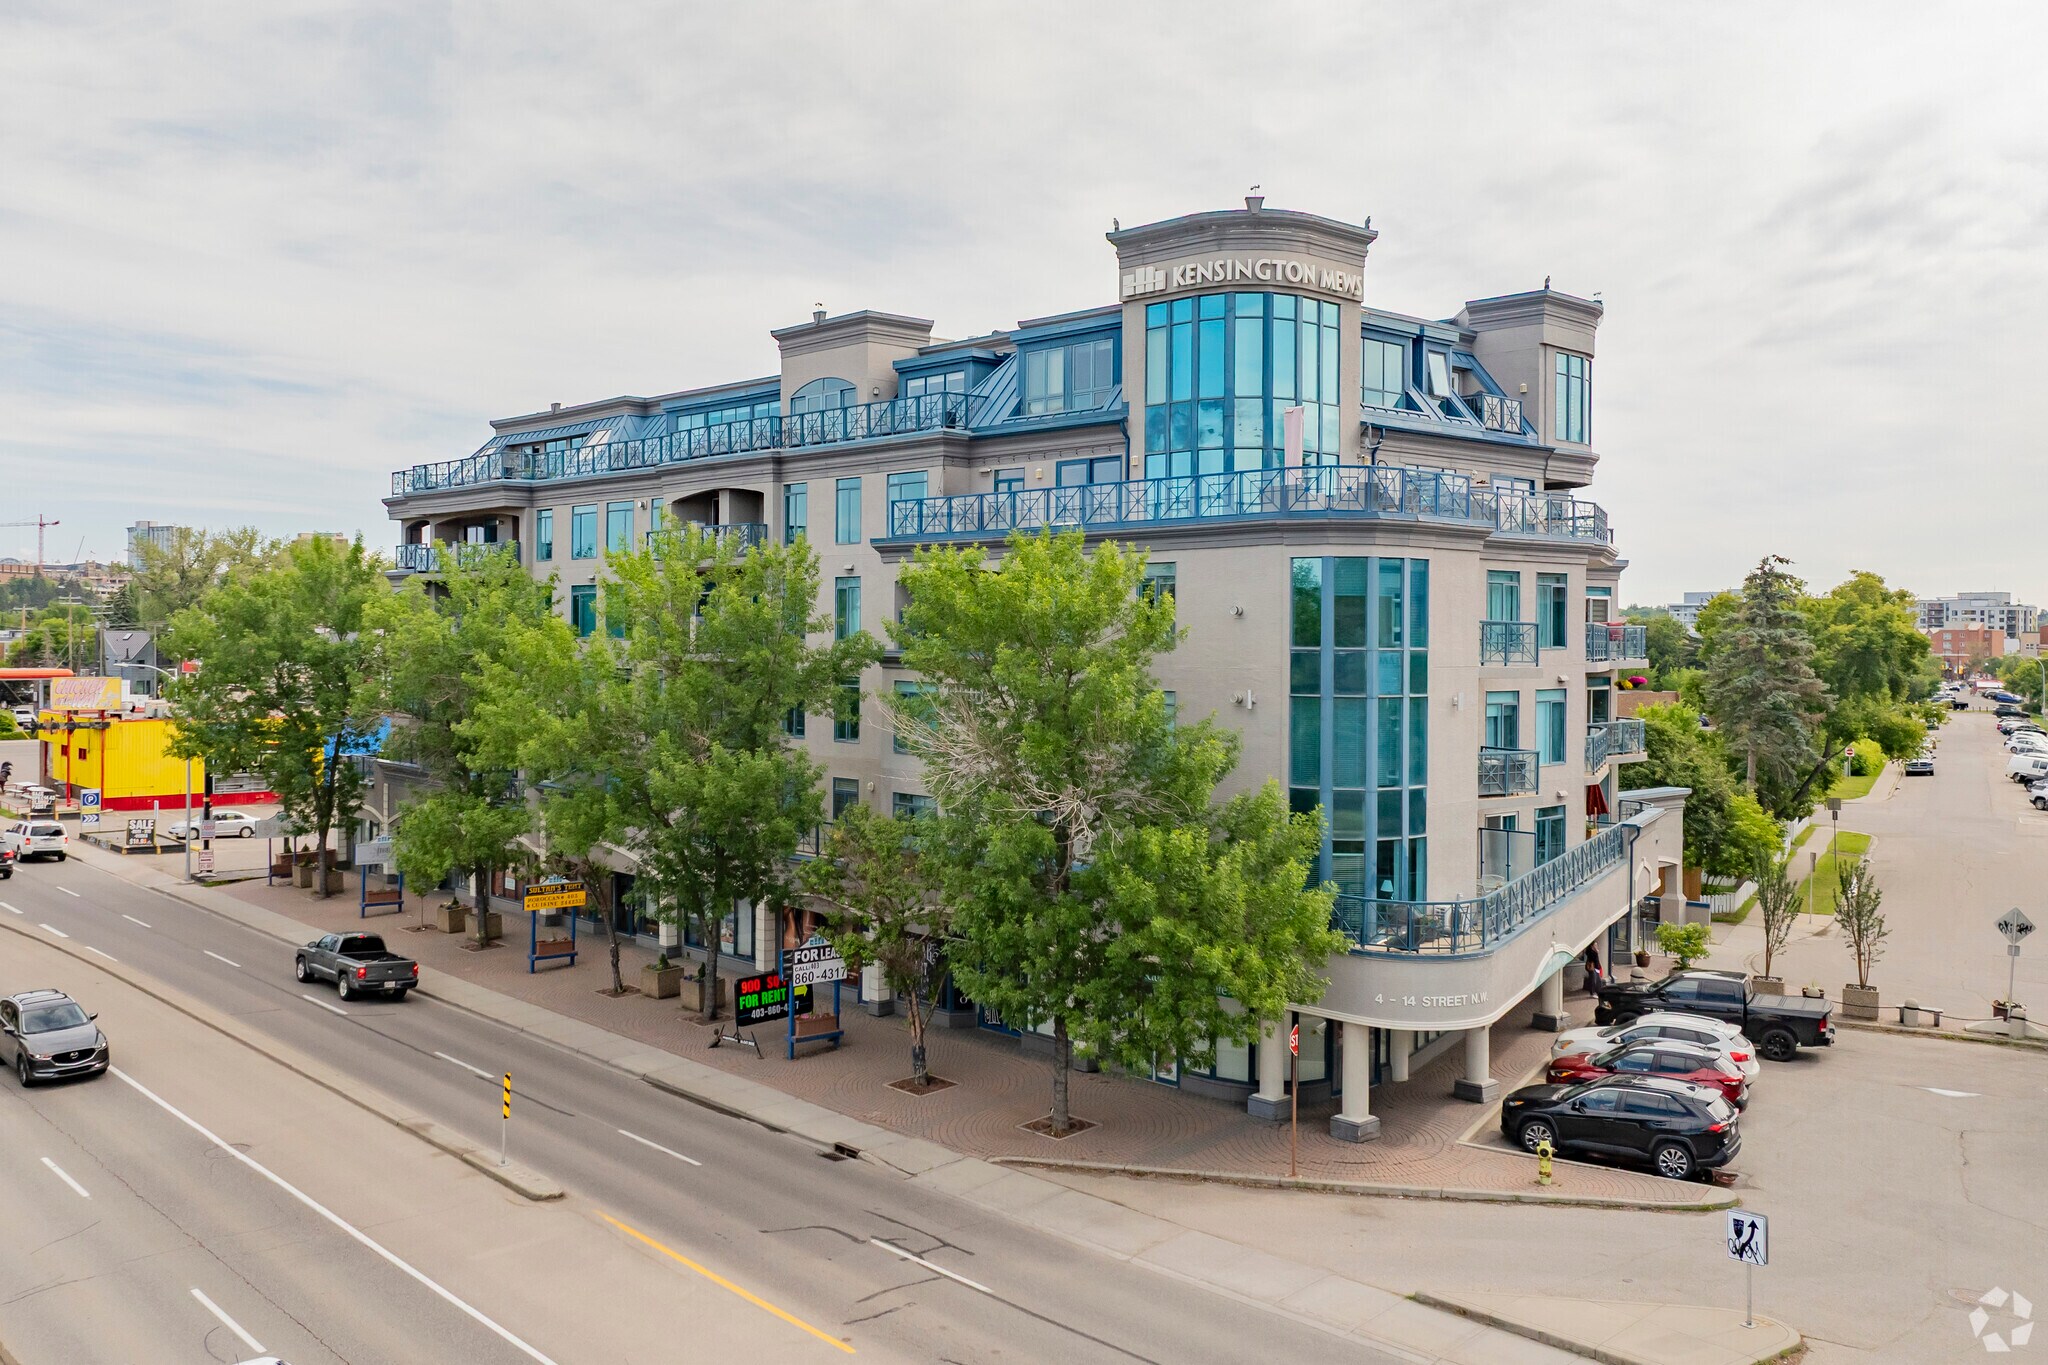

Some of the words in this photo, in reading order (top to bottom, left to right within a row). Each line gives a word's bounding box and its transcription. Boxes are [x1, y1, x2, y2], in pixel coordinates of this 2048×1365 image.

[1172, 257, 1317, 288] KENSINGTON
[1319, 267, 1363, 296] MEWS
[128, 819, 154, 830] SALE
[794, 948, 819, 964] FOR
[794, 966, 846, 985] 860-4317
[741, 979, 761, 994] 900
[740, 994, 760, 1010] FOR
[761, 988, 787, 1005] RENT
[1375, 993, 1384, 1004] 4
[1402, 995, 1417, 1006] 14
[1422, 994, 1468, 1007] STREET
[751, 1000, 799, 1019] 403-860-47
